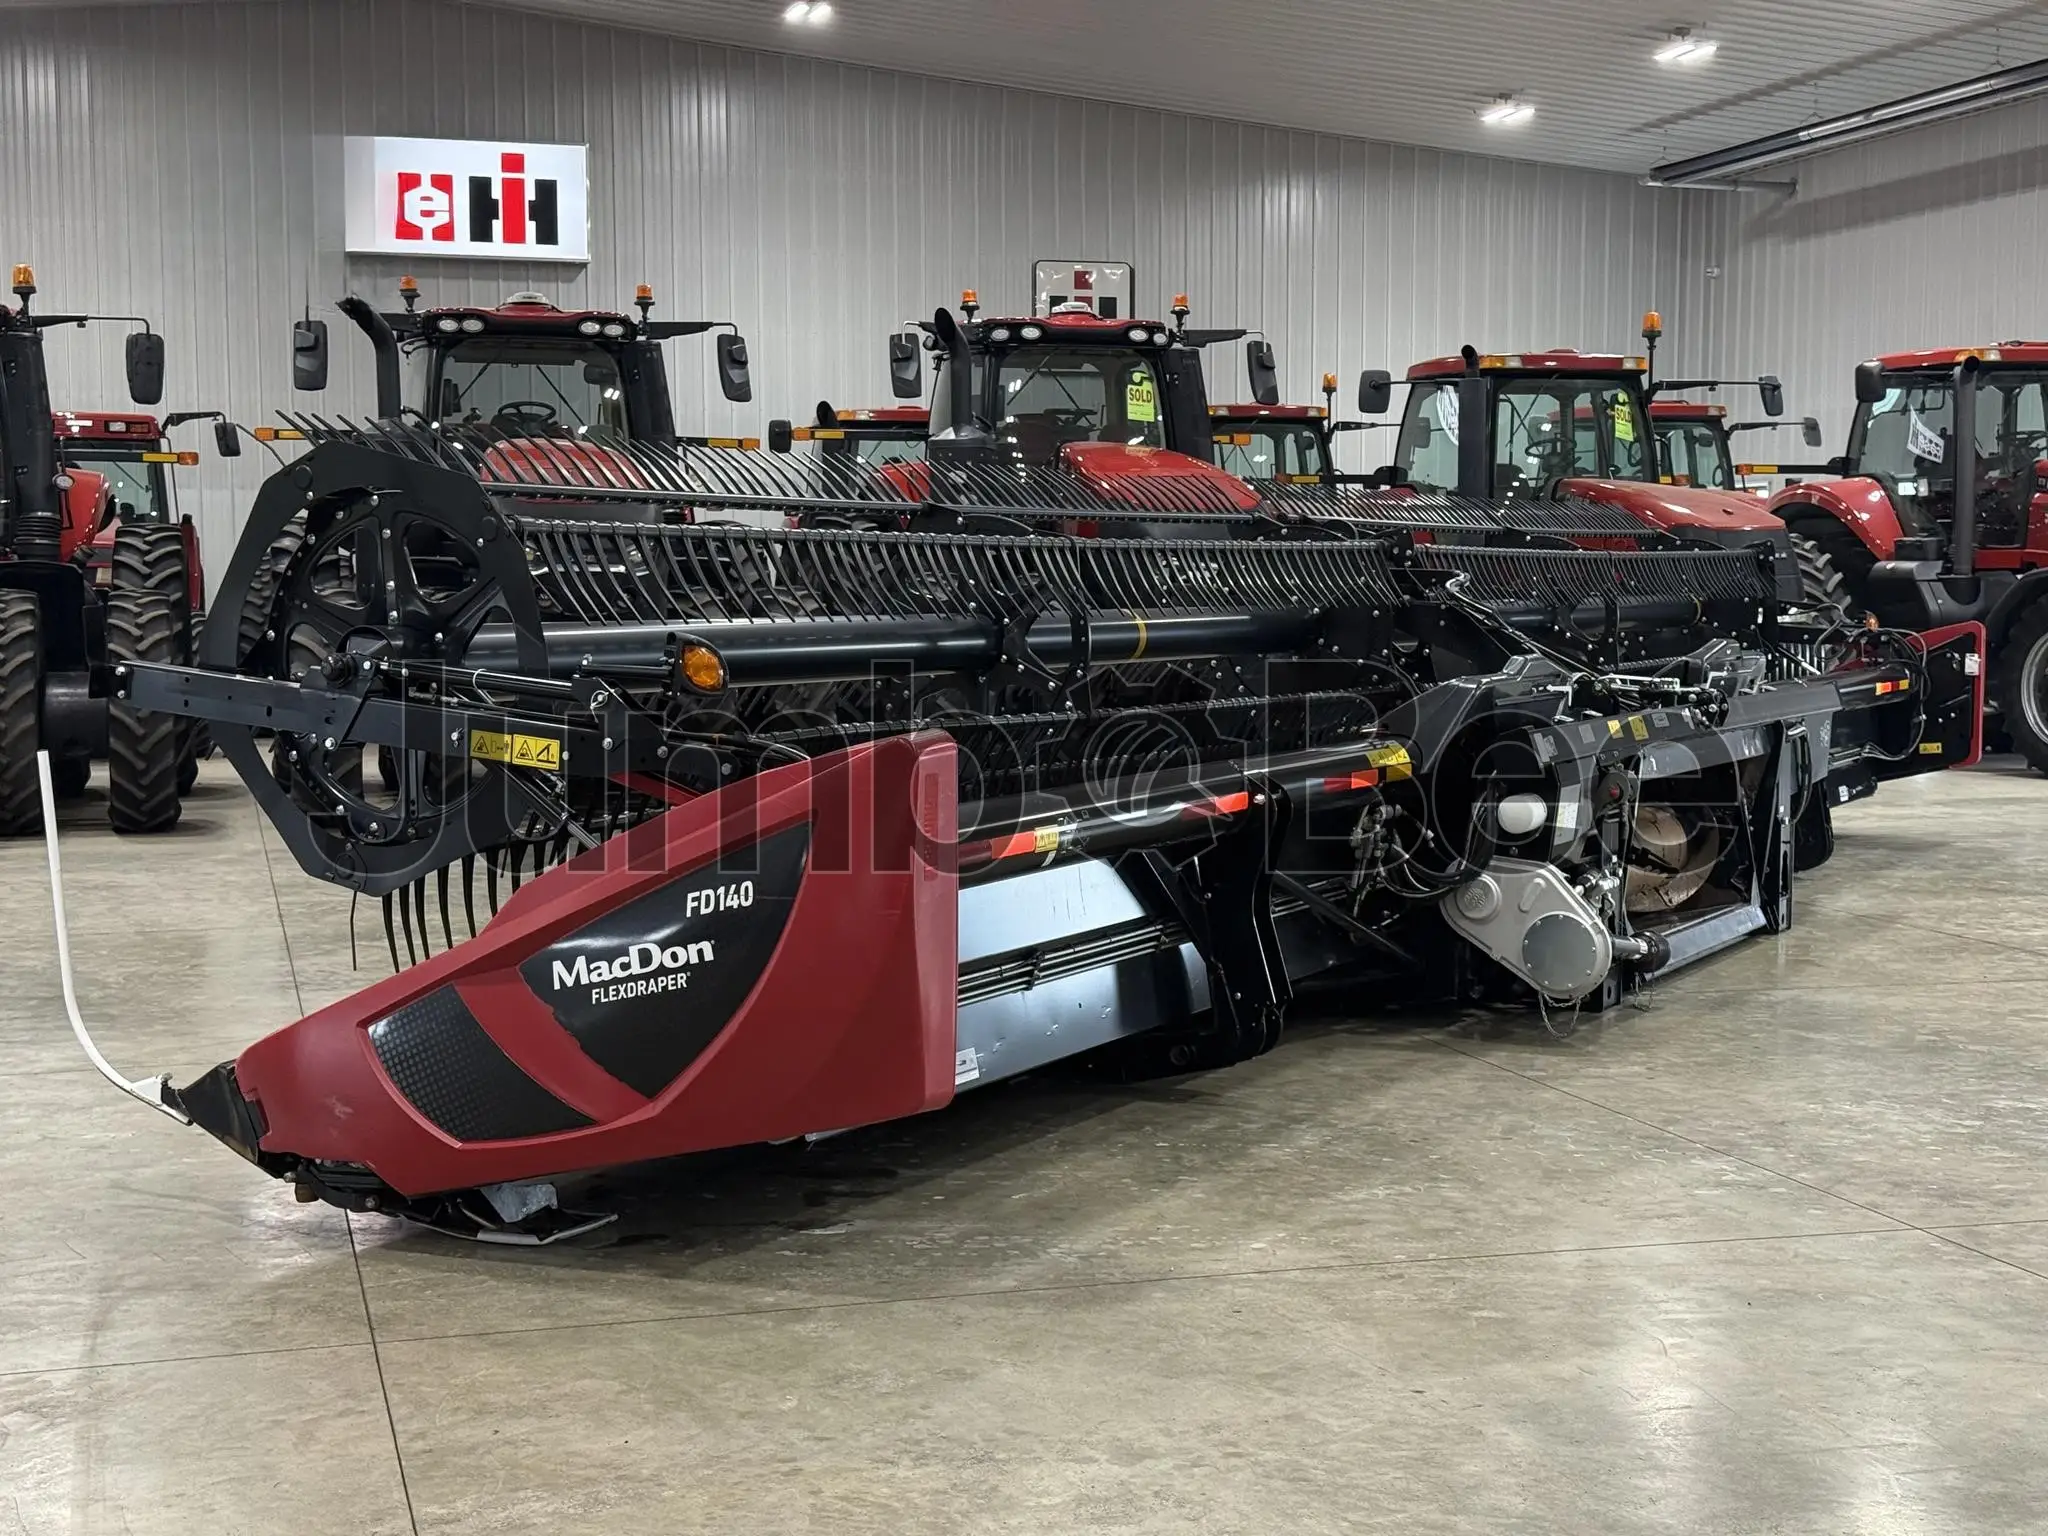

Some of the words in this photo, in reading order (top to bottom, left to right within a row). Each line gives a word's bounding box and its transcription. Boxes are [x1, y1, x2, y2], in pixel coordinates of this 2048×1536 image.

[1129, 387, 1152, 403] SOLD
[686, 880, 754, 918] FD140
[552, 940, 714, 990] MacDon
[591, 973, 688, 1004] FLEXDRAPER
